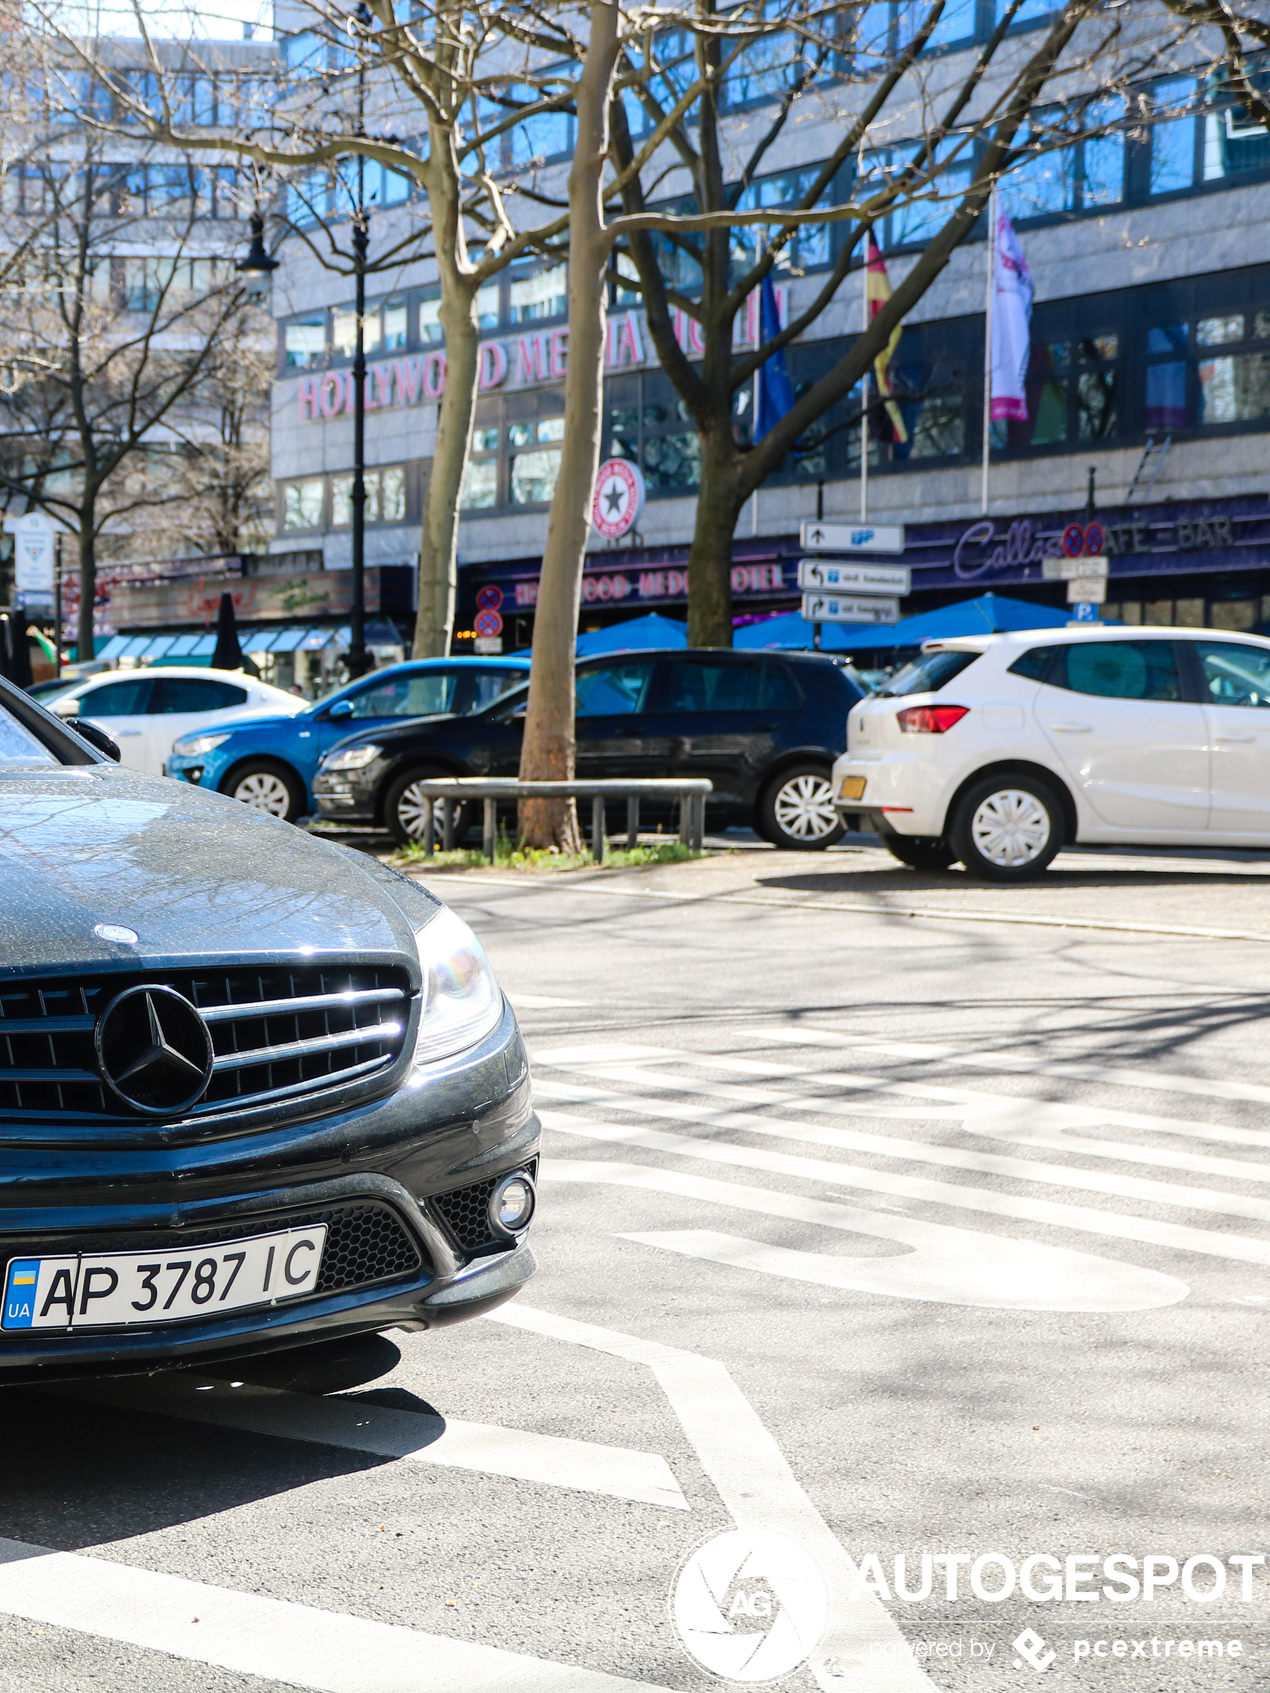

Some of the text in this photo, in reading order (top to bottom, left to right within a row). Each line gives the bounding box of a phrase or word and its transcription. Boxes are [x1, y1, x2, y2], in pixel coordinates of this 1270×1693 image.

[299, 341, 508, 420] HOLLYWOD
[516, 307, 644, 383] MEIA
[1177, 515, 1233, 549] BAR
[731, 564, 786, 593] OTEL
[39, 1239, 316, 1317] AP 3787 IC
[8, 1303, 31, 1318] UA
